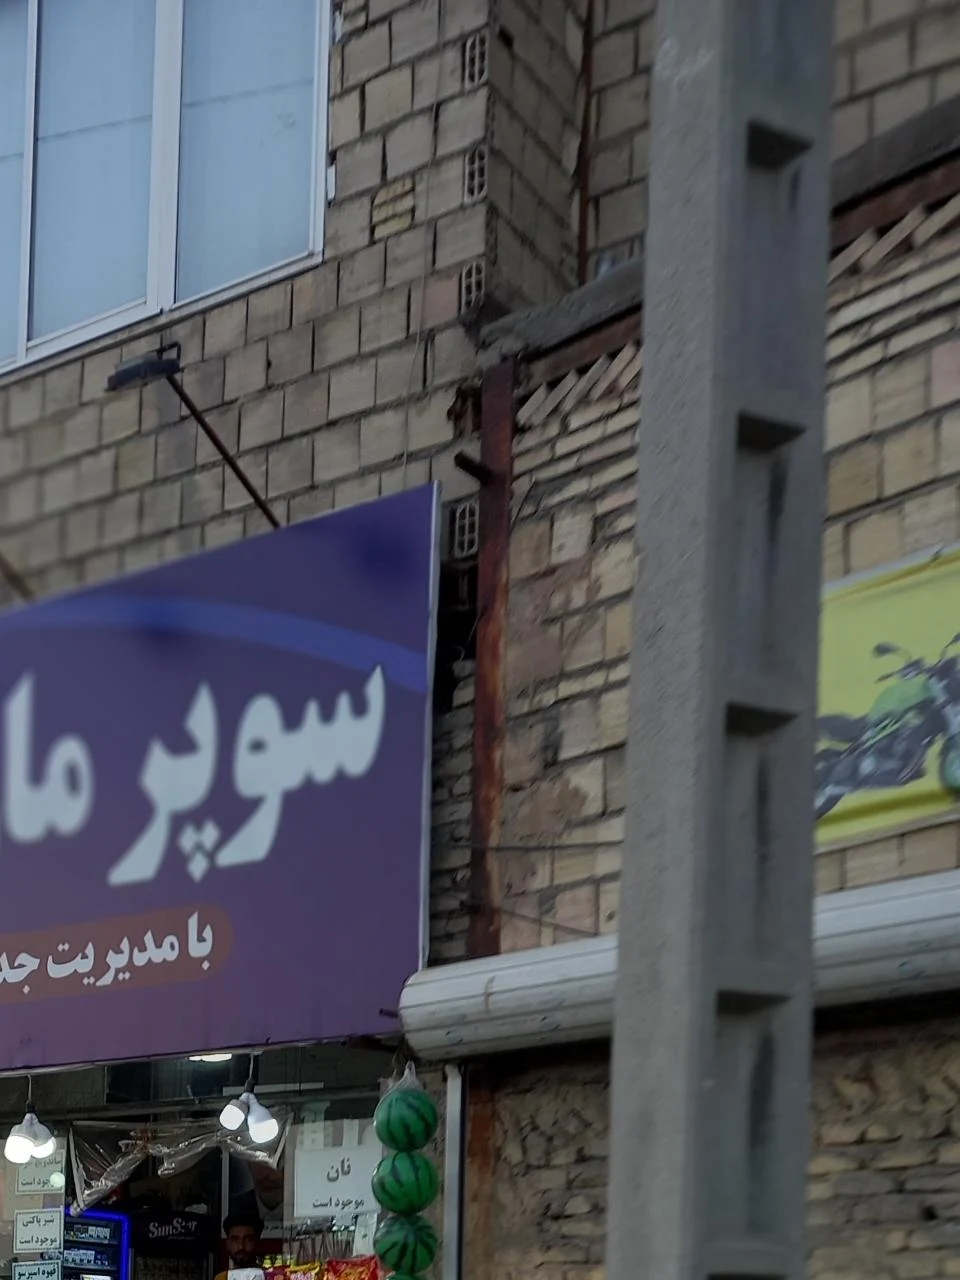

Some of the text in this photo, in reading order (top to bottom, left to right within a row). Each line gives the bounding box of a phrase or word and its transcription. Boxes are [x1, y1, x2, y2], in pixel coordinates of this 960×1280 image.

[108, 663, 386, 885] سوپر
[46, 929, 180, 987] مدیریت
[187, 911, 214, 971] با
[326, 1157, 352, 1182] نان
[312, 1196, 365, 1210] موجود است
